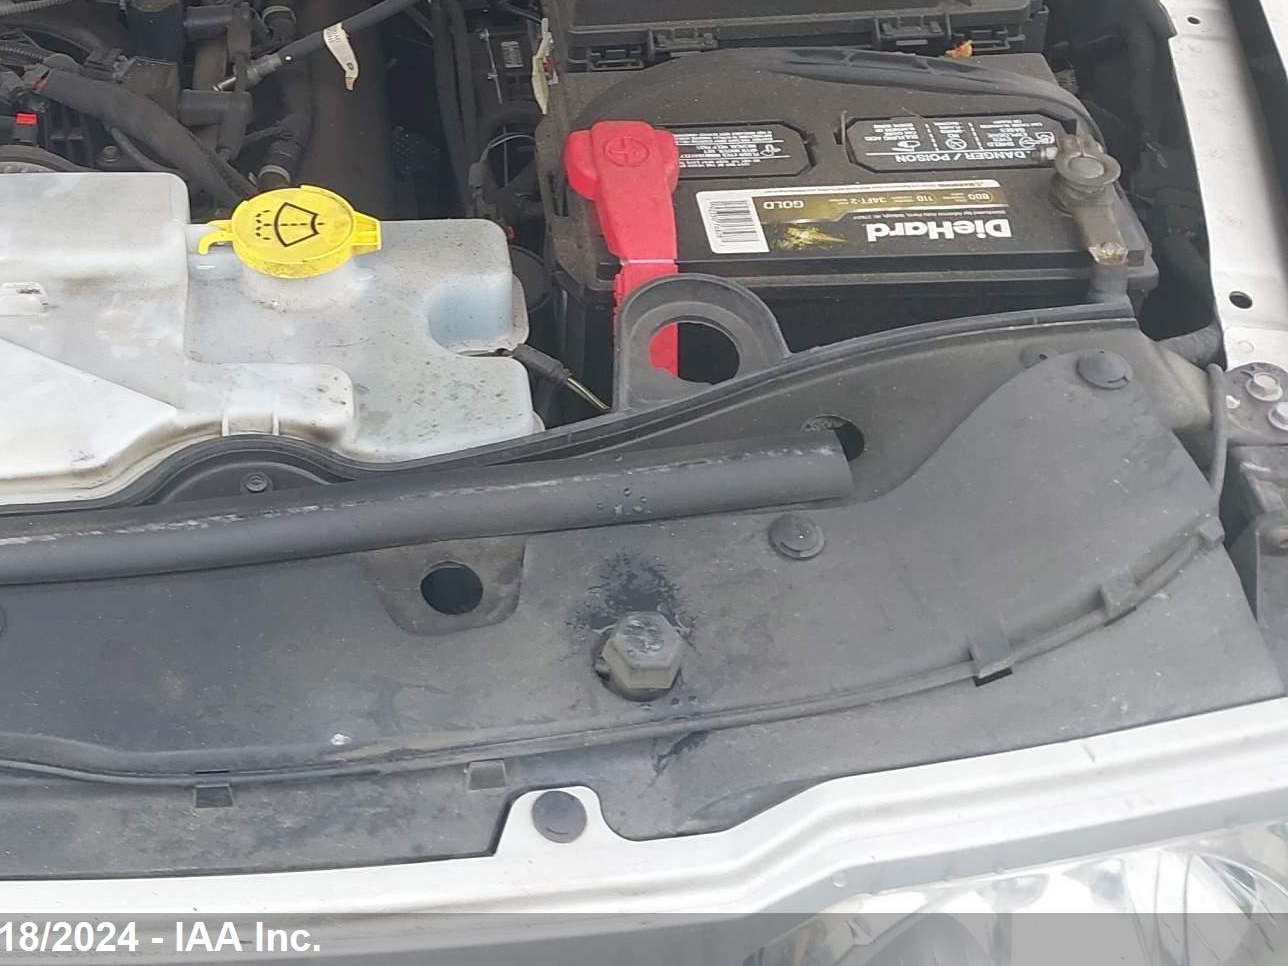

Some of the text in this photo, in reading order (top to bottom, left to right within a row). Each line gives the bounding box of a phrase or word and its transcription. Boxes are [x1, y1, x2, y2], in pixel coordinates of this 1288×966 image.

[894, 154, 951, 163] POISON
[964, 151, 1026, 160] DANGER
[850, 196, 888, 205] 34FT-2
[916, 194, 934, 202] 110
[763, 200, 805, 210] GOLD
[865, 219, 1012, 242] DieHard
